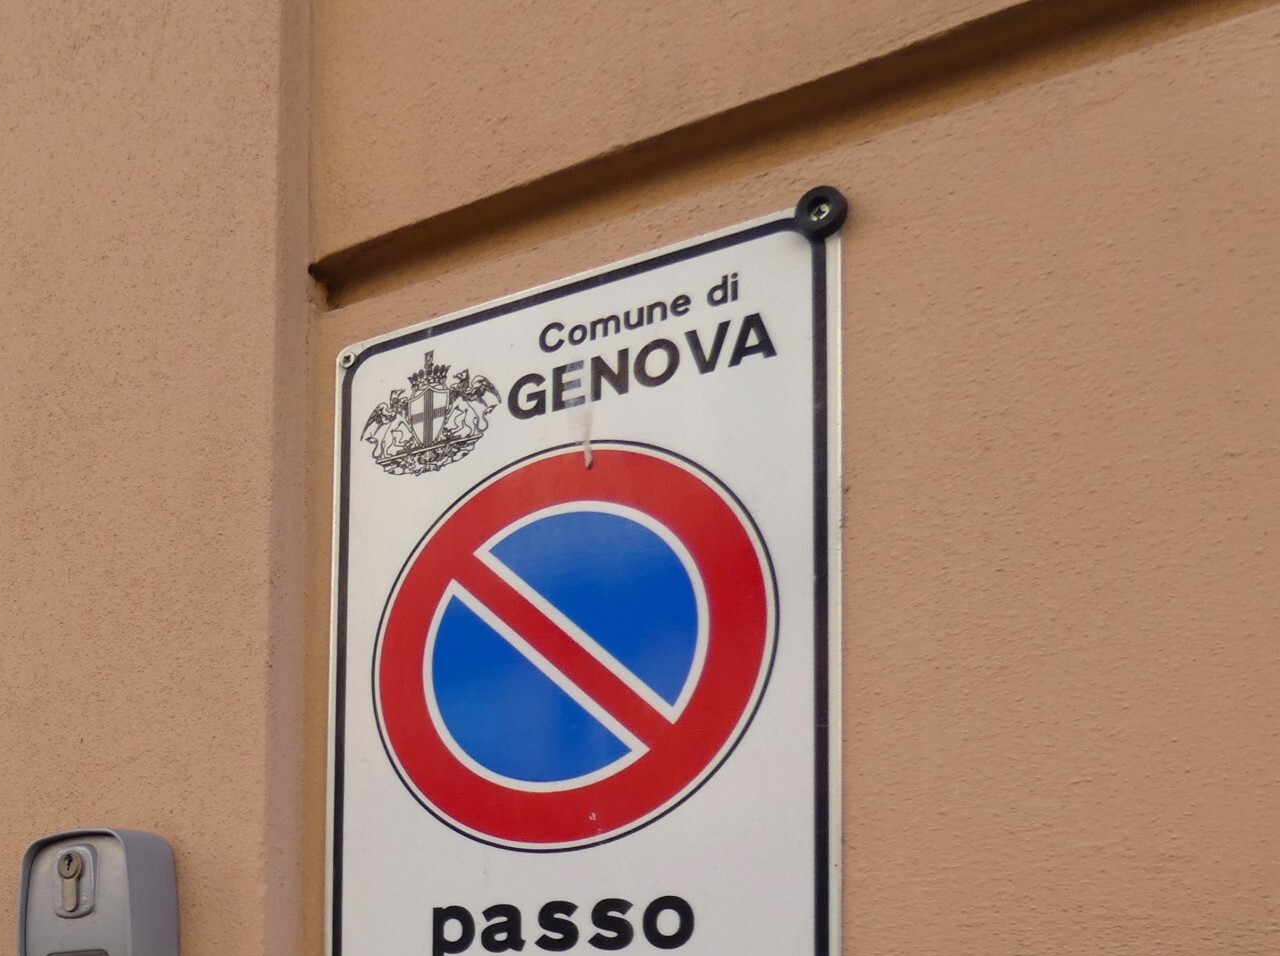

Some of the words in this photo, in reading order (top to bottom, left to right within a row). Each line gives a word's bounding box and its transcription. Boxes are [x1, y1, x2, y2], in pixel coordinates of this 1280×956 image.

[537, 289, 691, 353] Comune
[706, 272, 740, 308] di
[506, 312, 778, 421] GENOVA
